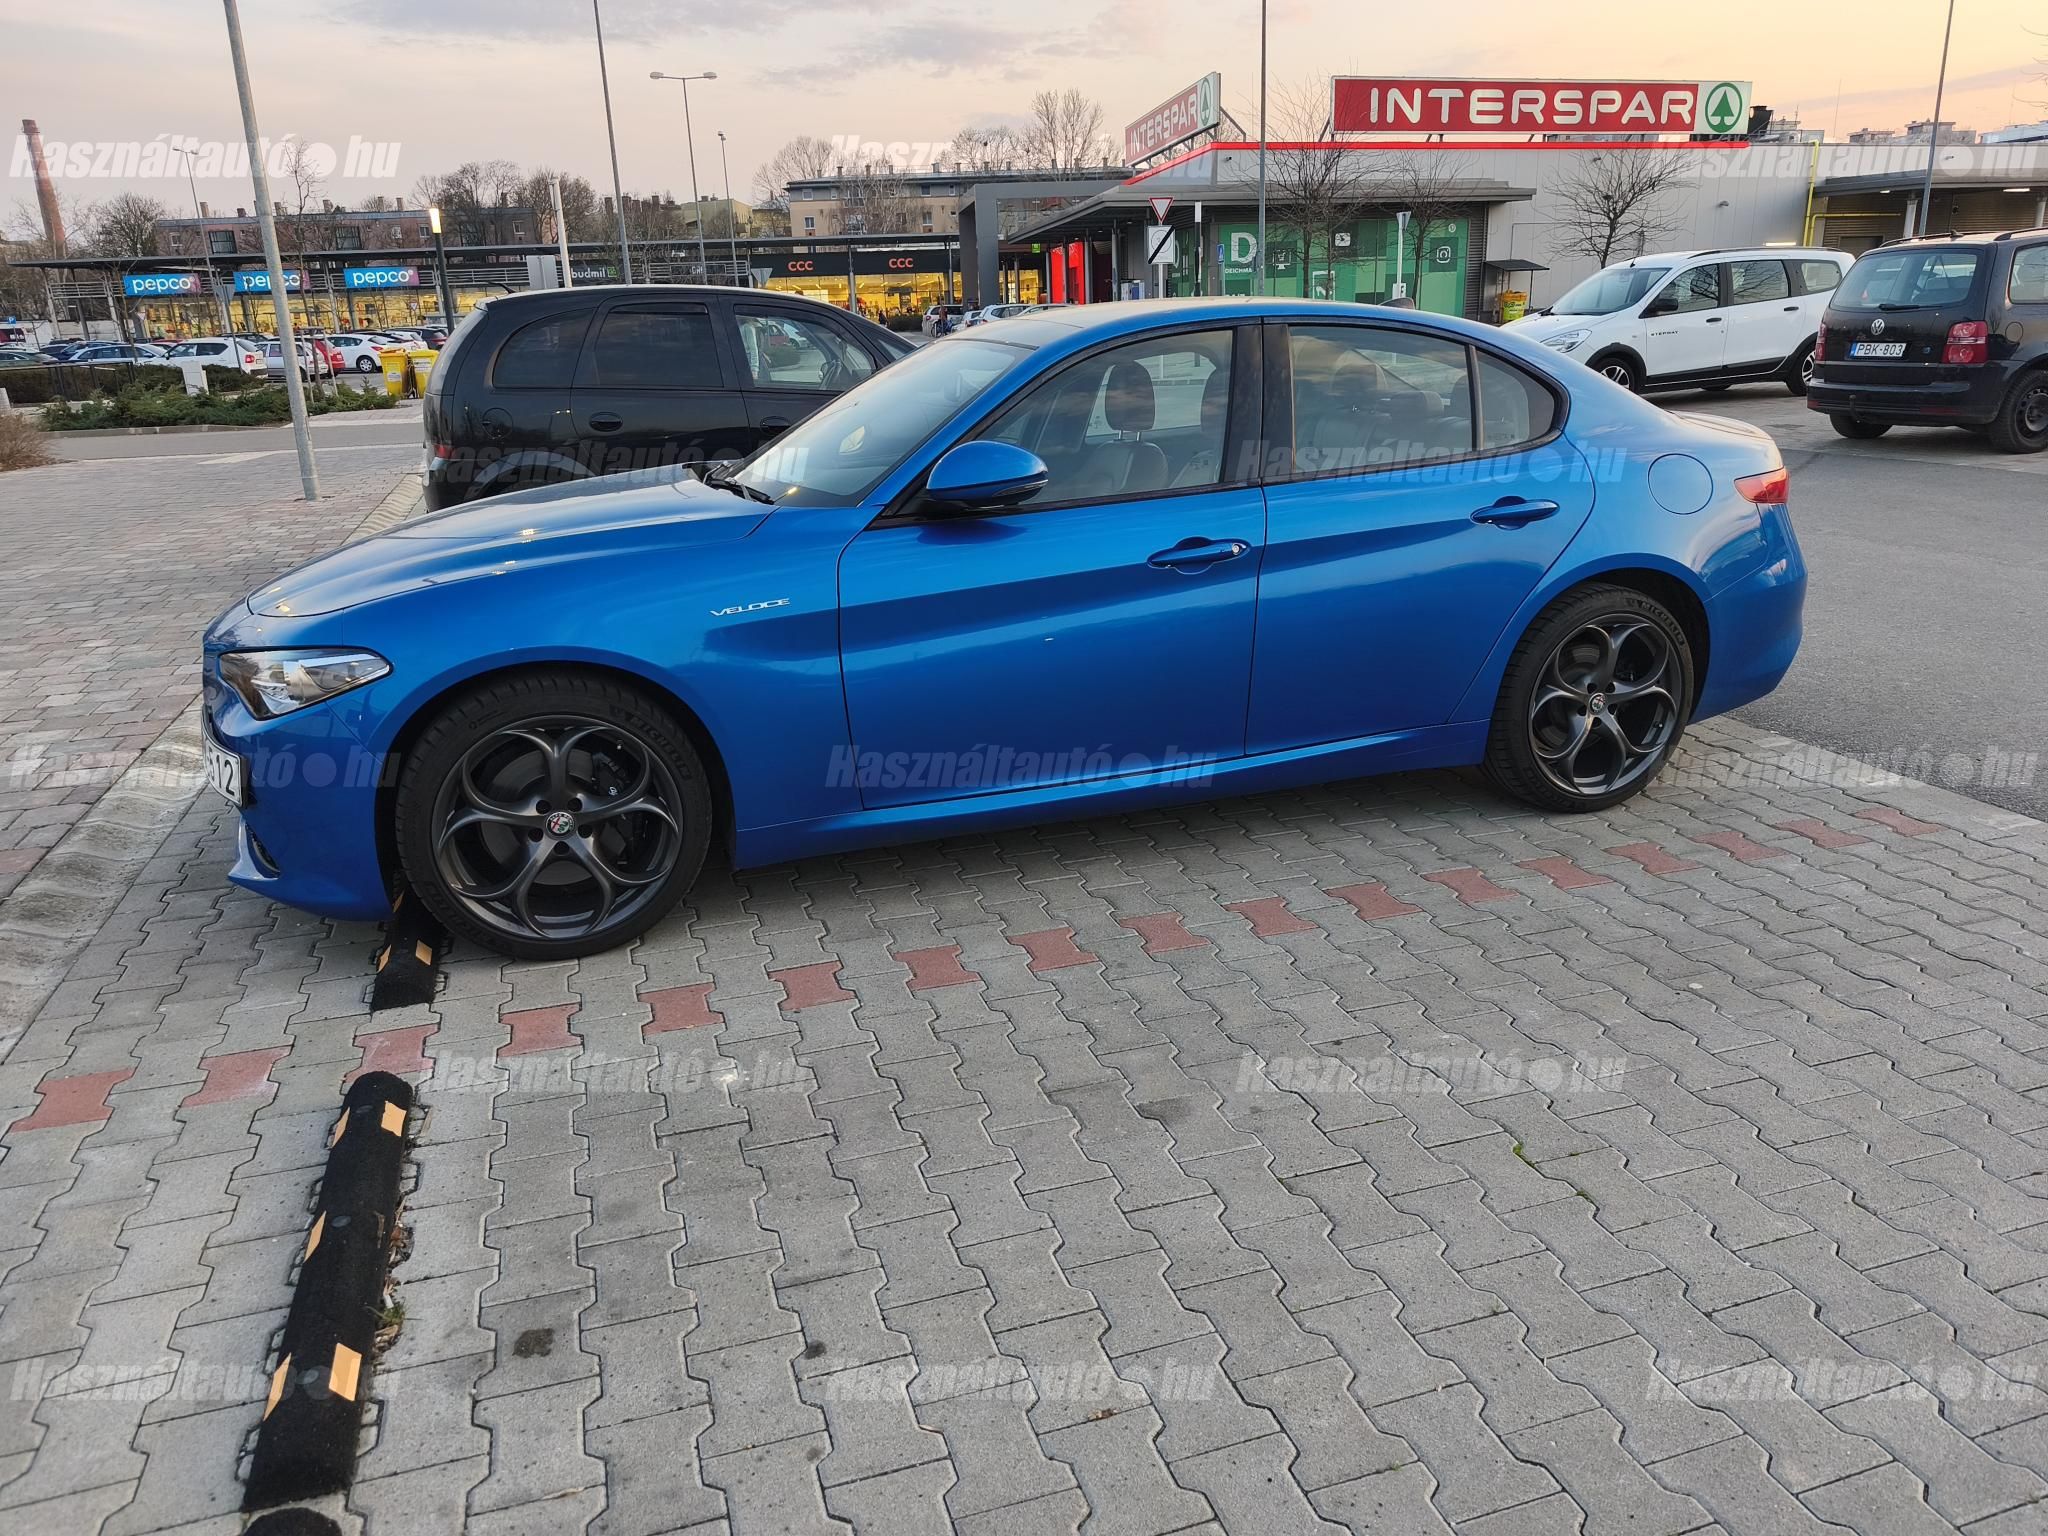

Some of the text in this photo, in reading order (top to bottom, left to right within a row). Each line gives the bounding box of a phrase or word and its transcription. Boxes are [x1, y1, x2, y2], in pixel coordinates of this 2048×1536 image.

[1369, 87, 1694, 124] INTERSPAR
[1130, 92, 1198, 157] INTERSPAR
[787, 261, 813, 271] CCC
[888, 258, 914, 268] CCC
[353, 269, 411, 287] pepco
[572, 267, 606, 278] budmil
[132, 275, 191, 293] pepco
[243, 274, 301, 290] peco
[1856, 344, 1904, 356] PBK-803
[709, 598, 790, 616] VELOCE
